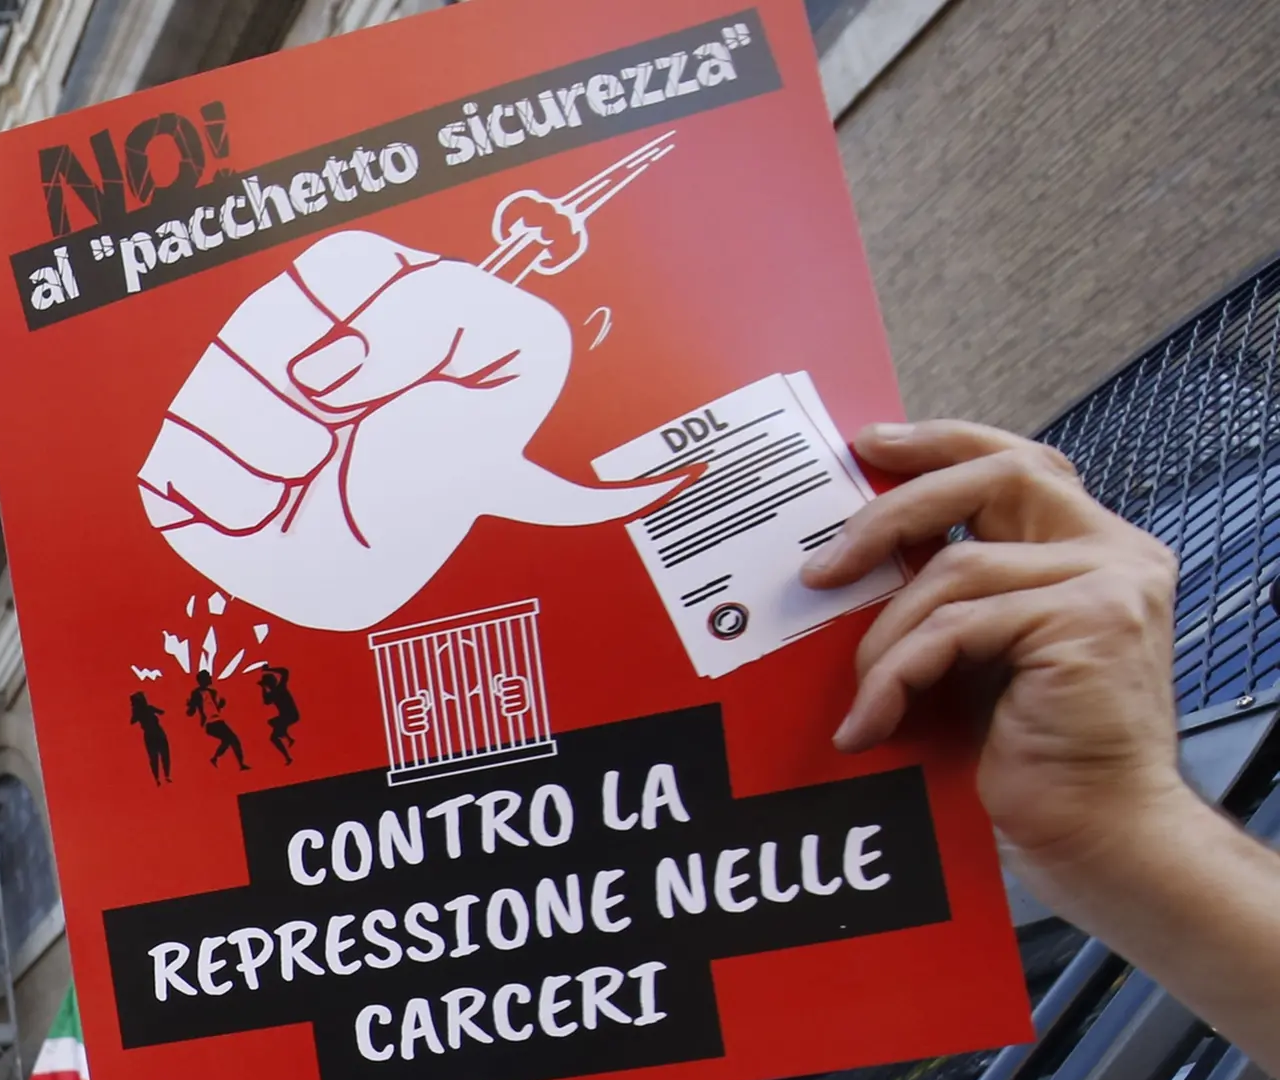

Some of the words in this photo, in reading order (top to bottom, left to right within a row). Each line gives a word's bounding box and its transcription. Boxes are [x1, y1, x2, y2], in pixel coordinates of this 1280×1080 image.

[38, 101, 232, 238] NO!
[29, 246, 79, 310] al
[661, 408, 729, 453] DDL
[288, 784, 573, 885] CONTRO
[603, 764, 690, 830] LA
[148, 870, 631, 1001] REPRESSIONE
[656, 825, 890, 918] NELLE
[355, 962, 666, 1061] CARCERI
